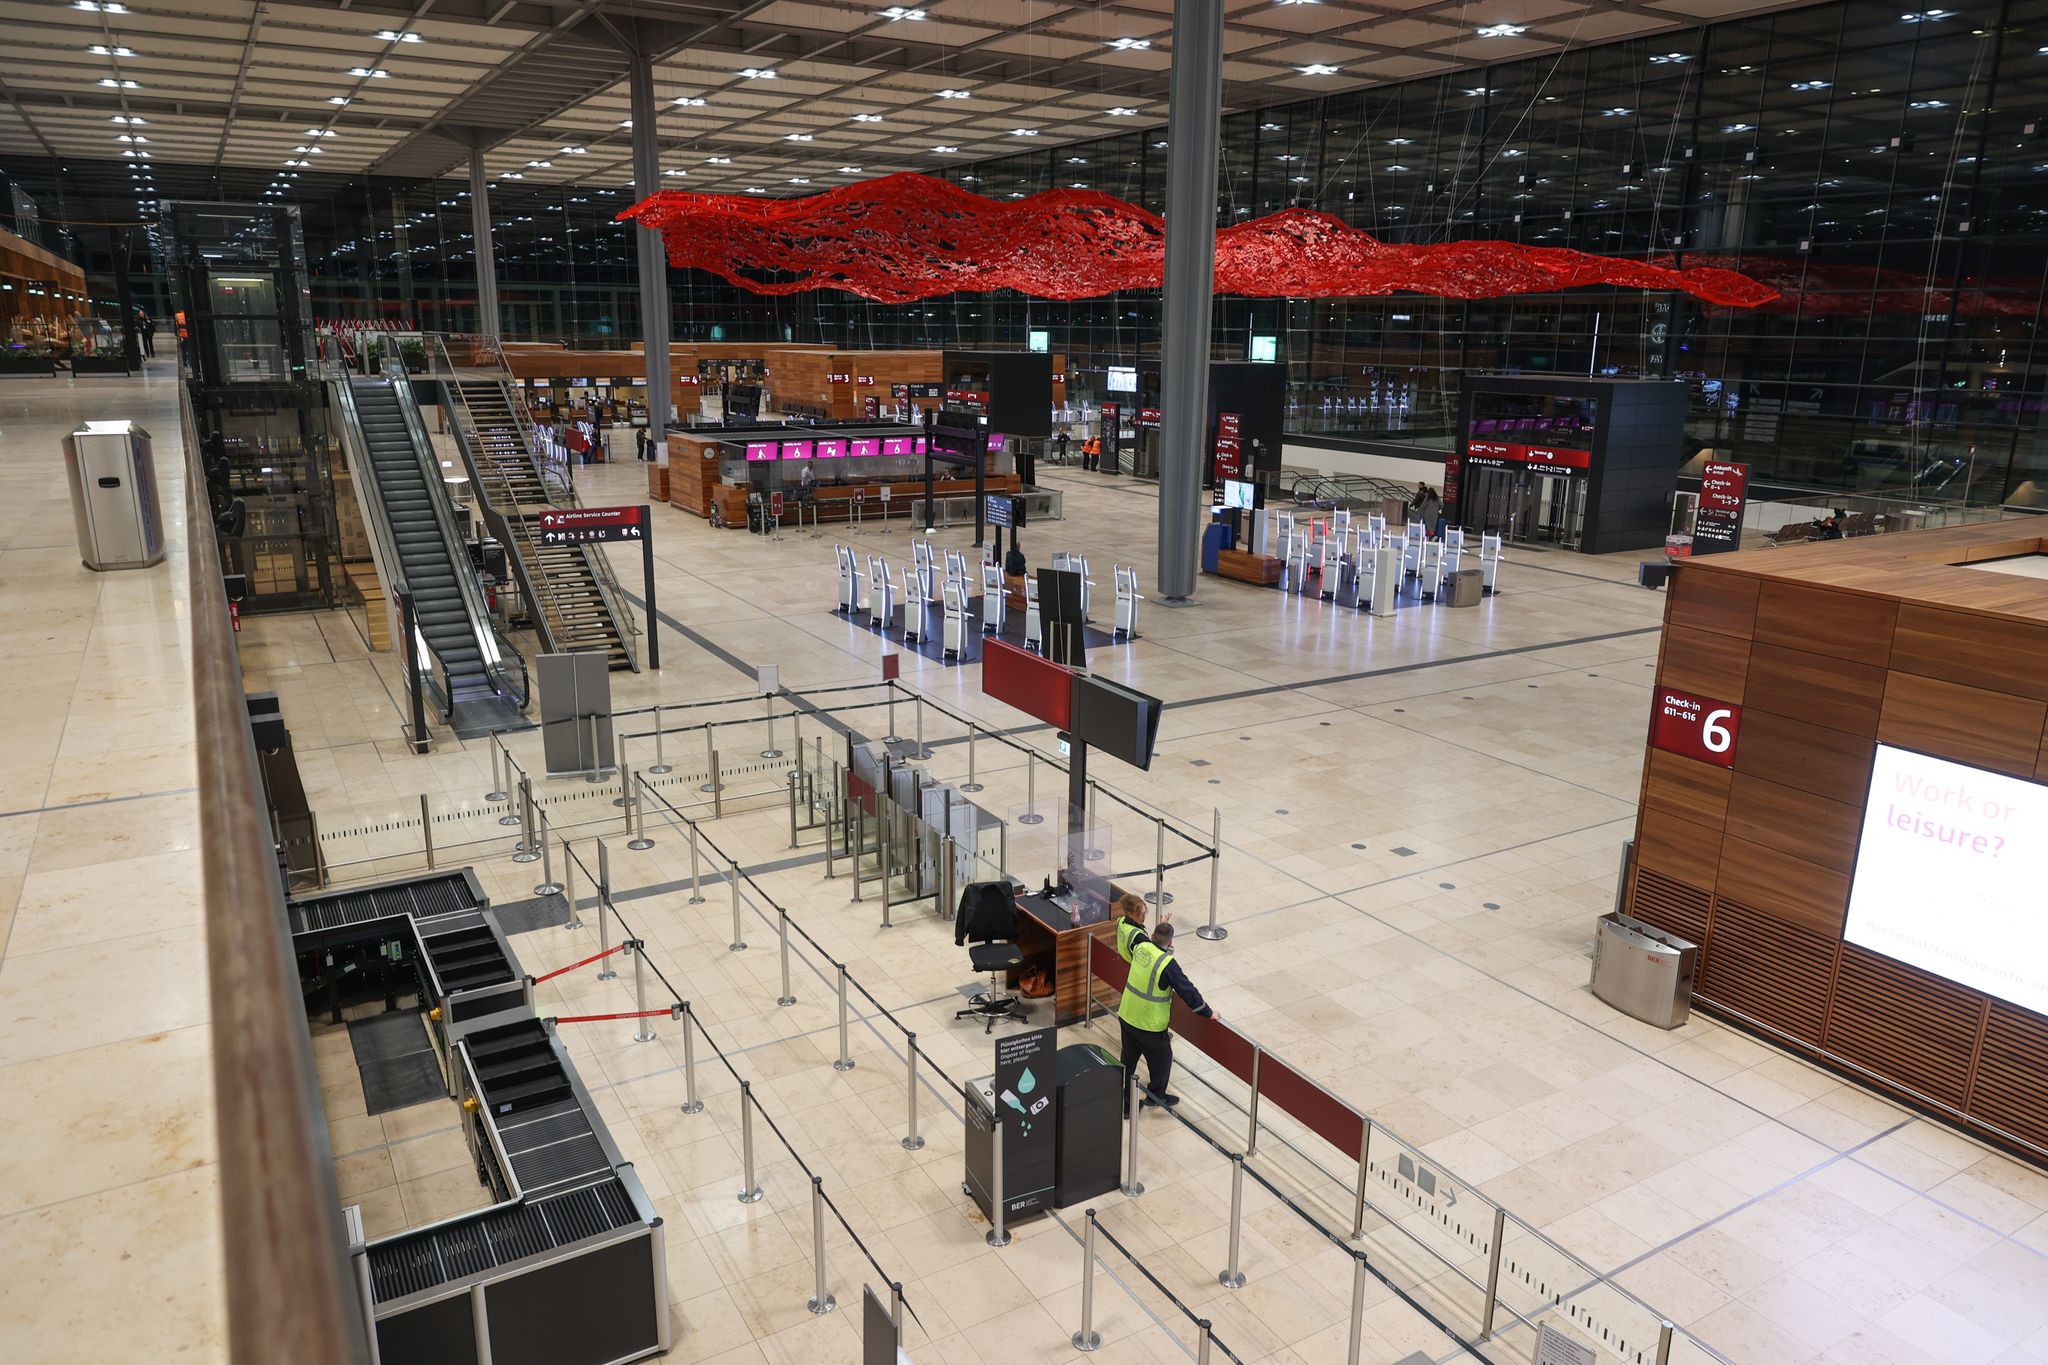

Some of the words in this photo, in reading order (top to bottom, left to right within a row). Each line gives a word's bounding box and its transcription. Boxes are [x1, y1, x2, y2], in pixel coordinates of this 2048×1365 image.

[691, 376, 698, 385] 4
[844, 374, 850, 383] 3
[868, 376, 874, 385] 3
[1665, 695, 1701, 711] Check-in
[1702, 709, 1732, 753] 6
[1894, 770, 1976, 813] Work
[1982, 798, 2018, 824] or
[1886, 803, 2006, 859] leisure?
[1000, 1052, 1018, 1060] Dispose
[1024, 1046, 1041, 1054] liquids
[1011, 1201, 1026, 1211] BER
